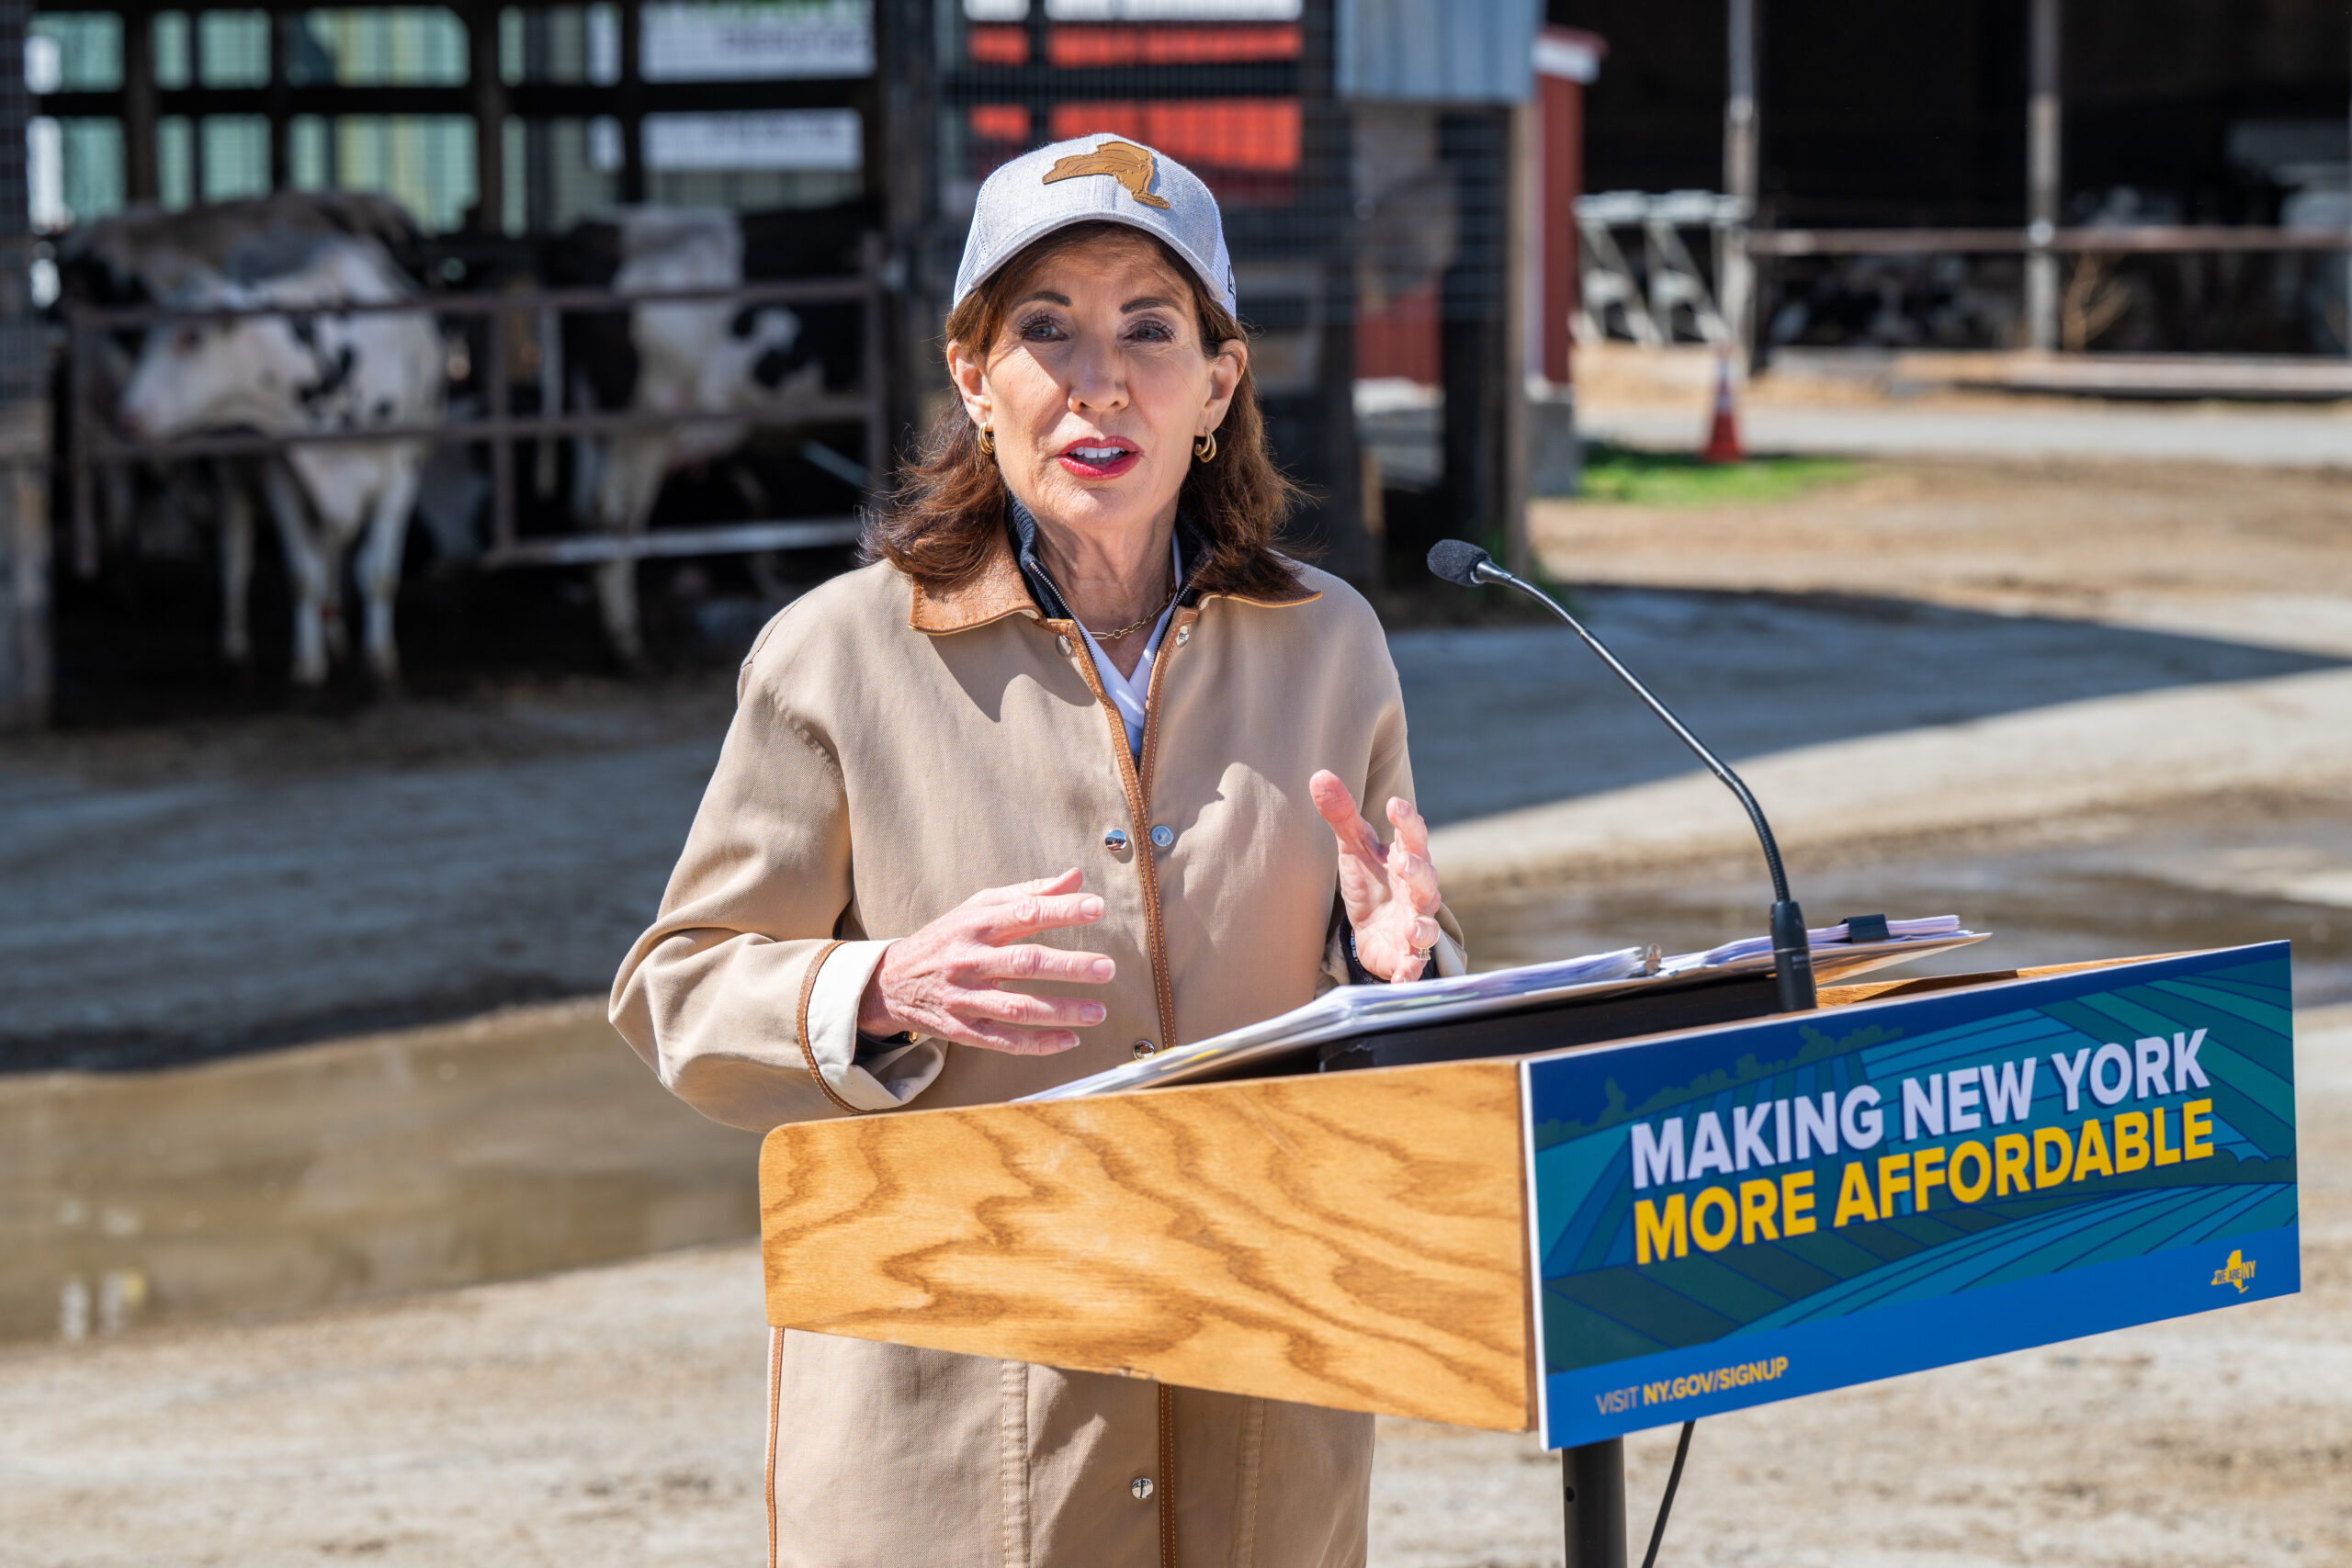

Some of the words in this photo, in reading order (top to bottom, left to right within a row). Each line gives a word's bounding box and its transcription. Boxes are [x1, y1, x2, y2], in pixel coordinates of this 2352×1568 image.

[1631, 1085, 1884, 1190] MAKING
[1903, 1057, 2037, 1141] NEW
[2051, 1028, 2211, 1111] YORK
[1634, 1169, 1816, 1265] MORE
[1833, 1098, 2214, 1228] AFFORDABLE
[2242, 1259, 2256, 1280] NY
[1595, 1386, 1640, 1416] VISIT
[1643, 1356, 1789, 1406] NY.GOV/SIGNUP
